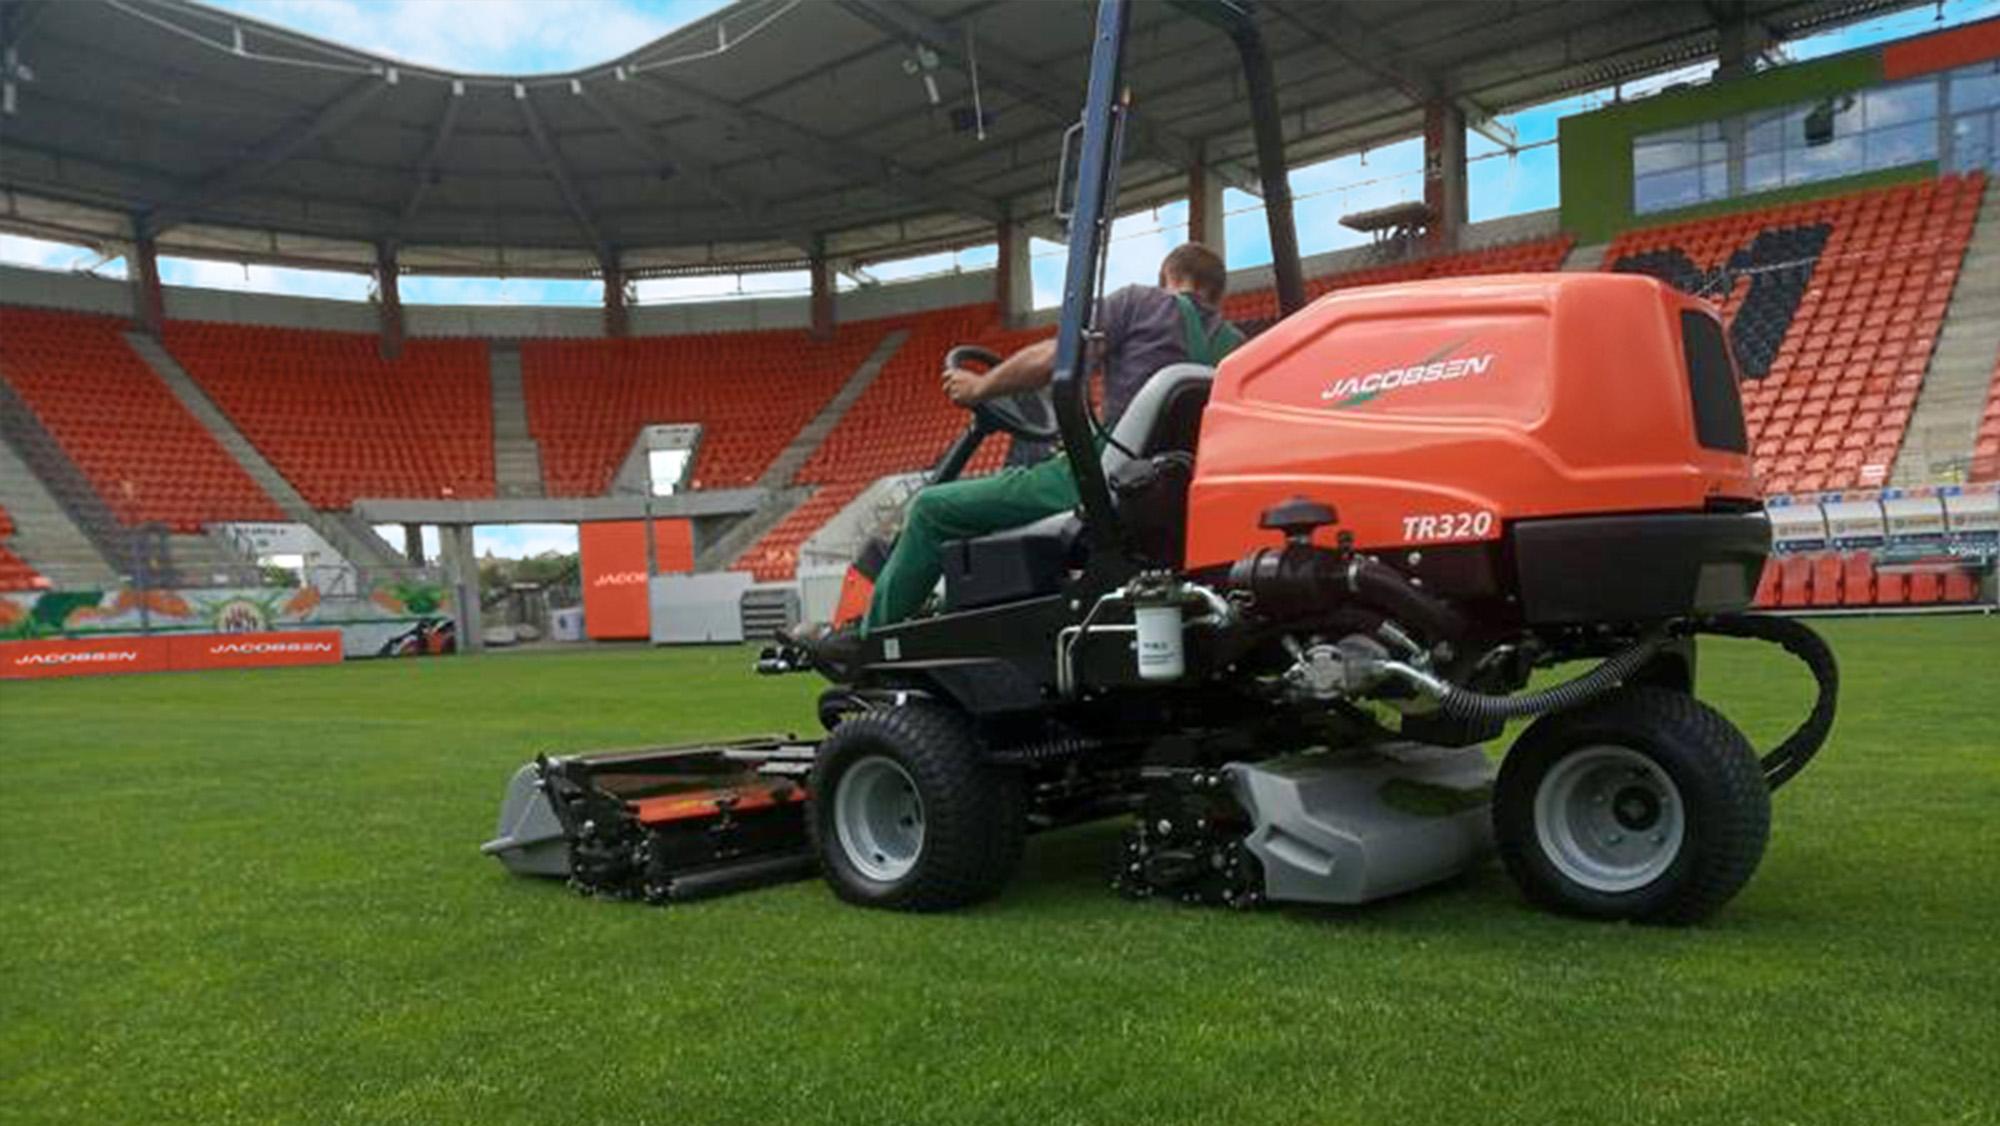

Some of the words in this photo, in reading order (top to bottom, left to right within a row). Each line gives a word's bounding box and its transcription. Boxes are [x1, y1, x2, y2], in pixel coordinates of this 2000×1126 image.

[1321, 354, 1493, 399] JACOBSEN
[1403, 511, 1492, 540] TR320
[15, 651, 137, 665] JACOBSEN
[210, 642, 333, 654] JACOBSEN
